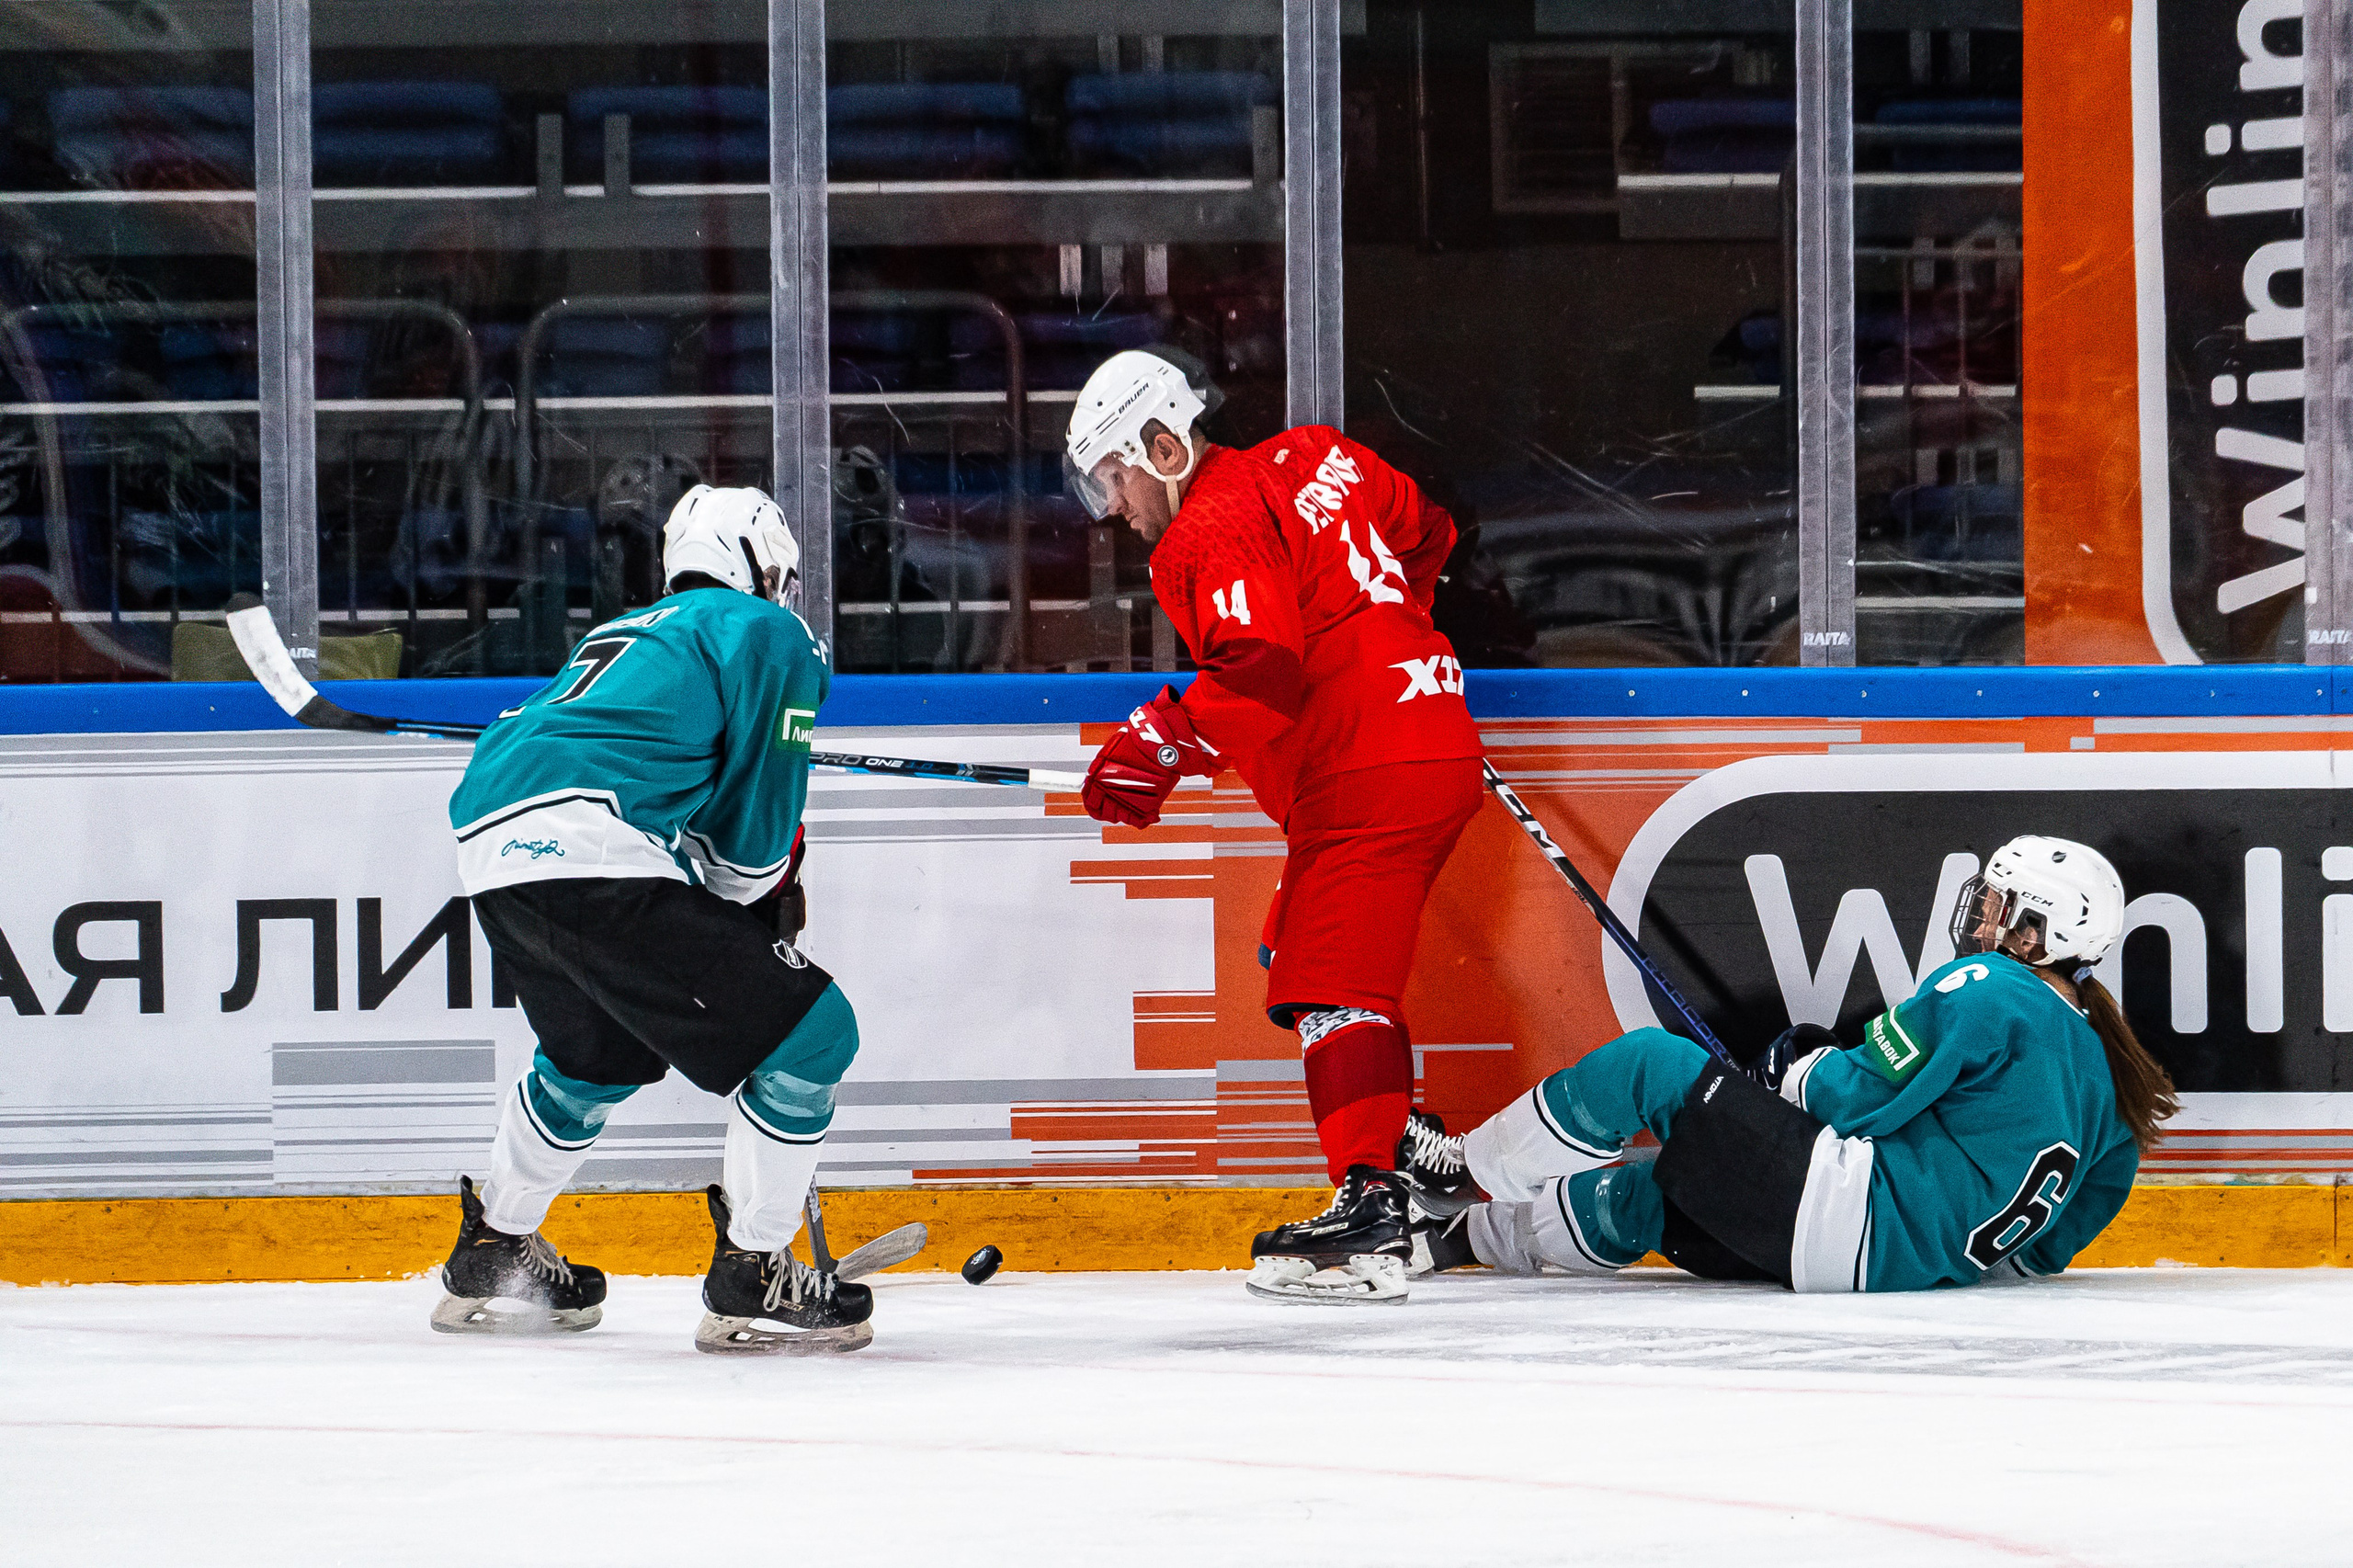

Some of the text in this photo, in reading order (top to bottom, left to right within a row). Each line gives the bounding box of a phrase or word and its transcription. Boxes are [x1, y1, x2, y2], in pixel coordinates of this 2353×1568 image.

[1119, 382, 1149, 415] BAUER
[1211, 579, 1251, 625] 14
[289, 647, 317, 660] AITA
[1802, 631, 1851, 645] RAITA
[865, 757, 904, 768] ONE
[2021, 891, 2054, 907] CCM
[1745, 846, 2353, 1033] Wnli
[1934, 963, 1990, 994] 6
[1963, 1141, 2080, 1271] 6
